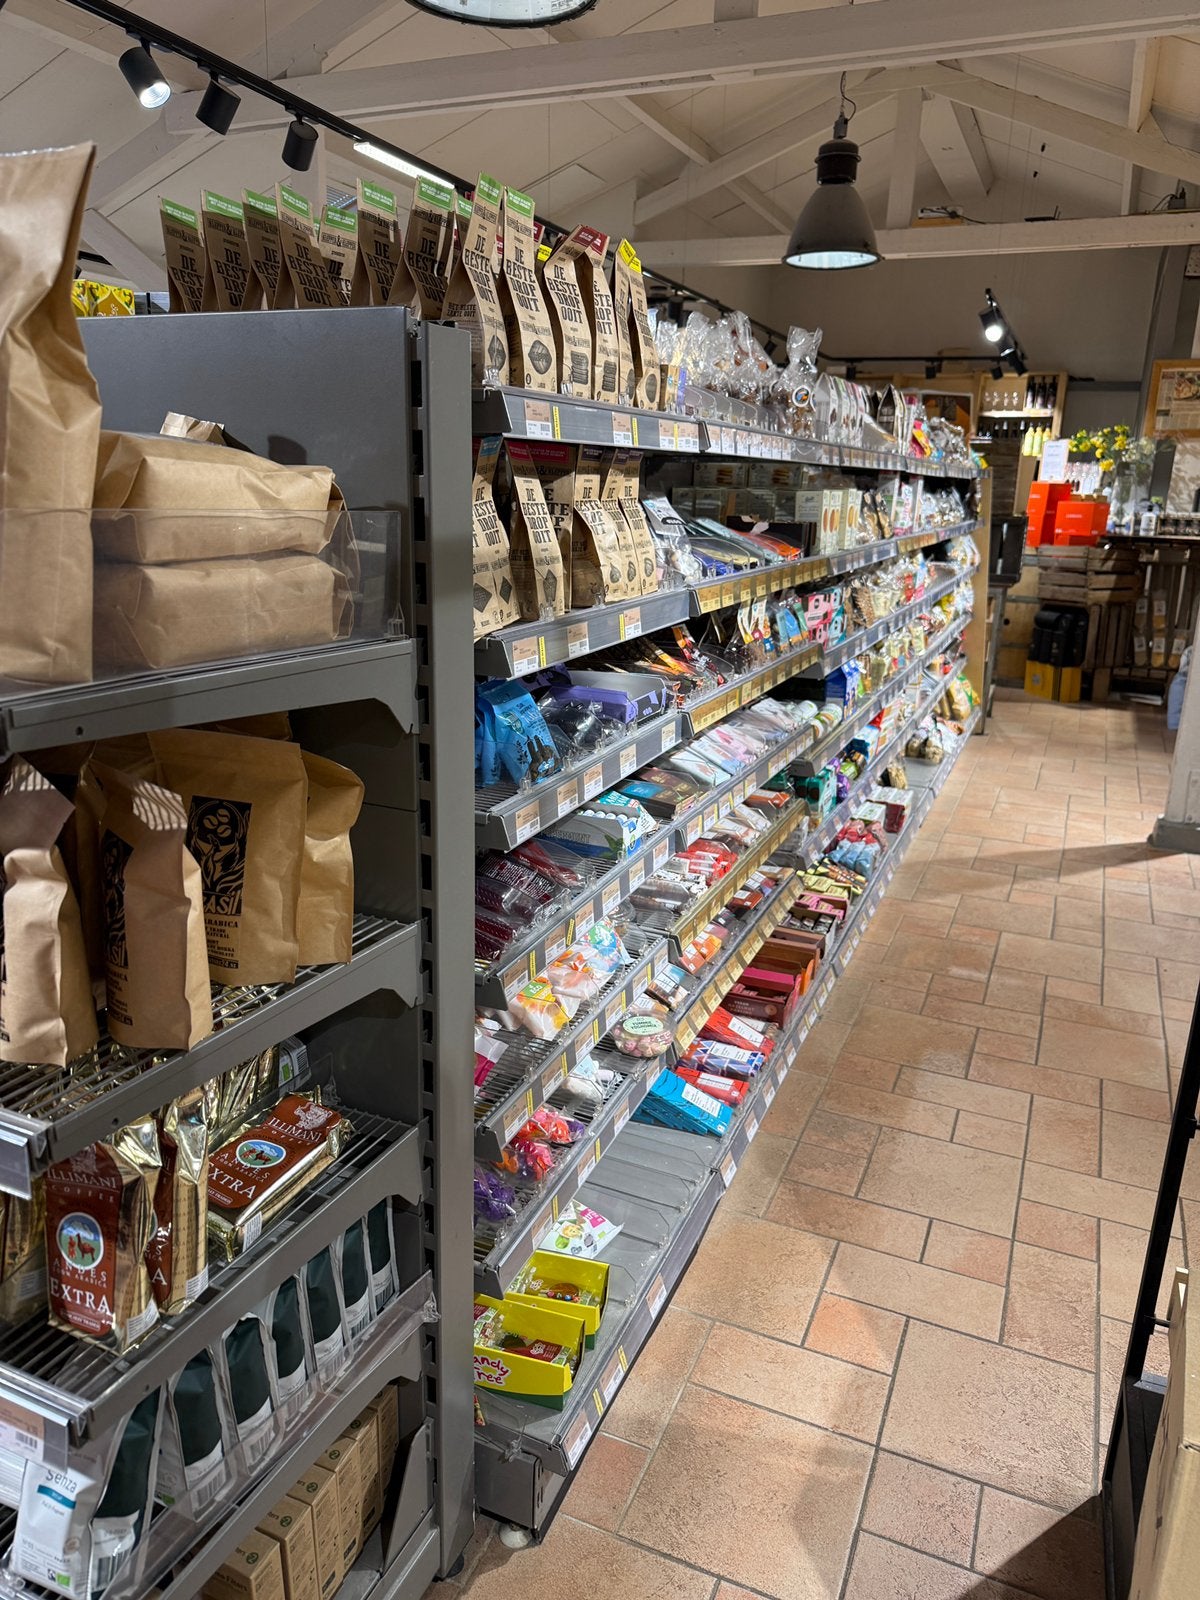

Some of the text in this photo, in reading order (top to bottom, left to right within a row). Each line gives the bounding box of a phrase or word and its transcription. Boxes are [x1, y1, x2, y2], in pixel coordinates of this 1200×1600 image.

[295, 242, 312, 263] DE
[374, 240, 389, 259] DE
[420, 237, 436, 257] DE
[474, 235, 486, 253] DE
[181, 254, 197, 272] DE
[224, 247, 242, 266] DE
[263, 246, 280, 264] DE
[366, 252, 397, 275] BEST
[407, 251, 445, 277] BESTE
[465, 249, 490, 272] BESTE
[514, 246, 524, 265] DE
[214, 260, 250, 283] BEST
[287, 254, 329, 279] BESTE
[328, 259, 344, 276] DE
[506, 259, 536, 284] BESTE
[553, 265, 566, 281] DE
[170, 266, 204, 288] BEST
[296, 271, 329, 293] DROP
[469, 268, 491, 288] DROP
[303, 286, 333, 307] OOIT
[476, 284, 496, 305] OOIT
[510, 277, 537, 297] DROP
[547, 277, 579, 297] BESTE
[516, 292, 540, 312] OOIT
[553, 291, 581, 309] DROP
[561, 307, 583, 324] OOIT
[475, 487, 485, 502] DE
[525, 488, 536, 502] DE
[582, 487, 593, 499] DE
[607, 487, 616, 499] DE
[624, 485, 633, 497] DE
[521, 502, 547, 516] BESTE
[574, 499, 602, 512] BESTE
[601, 499, 619, 511] BESTE
[621, 498, 639, 509] BESTE
[477, 515, 498, 532] DROP
[526, 516, 549, 530] DROP
[484, 530, 501, 547] OOIT
[268, 1117, 323, 1143] ILLIMANI
[220, 1152, 271, 1180] ANDES
[236, 1166, 265, 1183] ARABICA
[47, 1168, 118, 1190] ILLIMANI
[51, 1185, 114, 1203] COFFEE
[53, 1258, 108, 1282] ANDES
[74, 1274, 107, 1289] ARABICA
[50, 1277, 112, 1316] EXTRA
[45, 1469, 77, 1493] Senza
